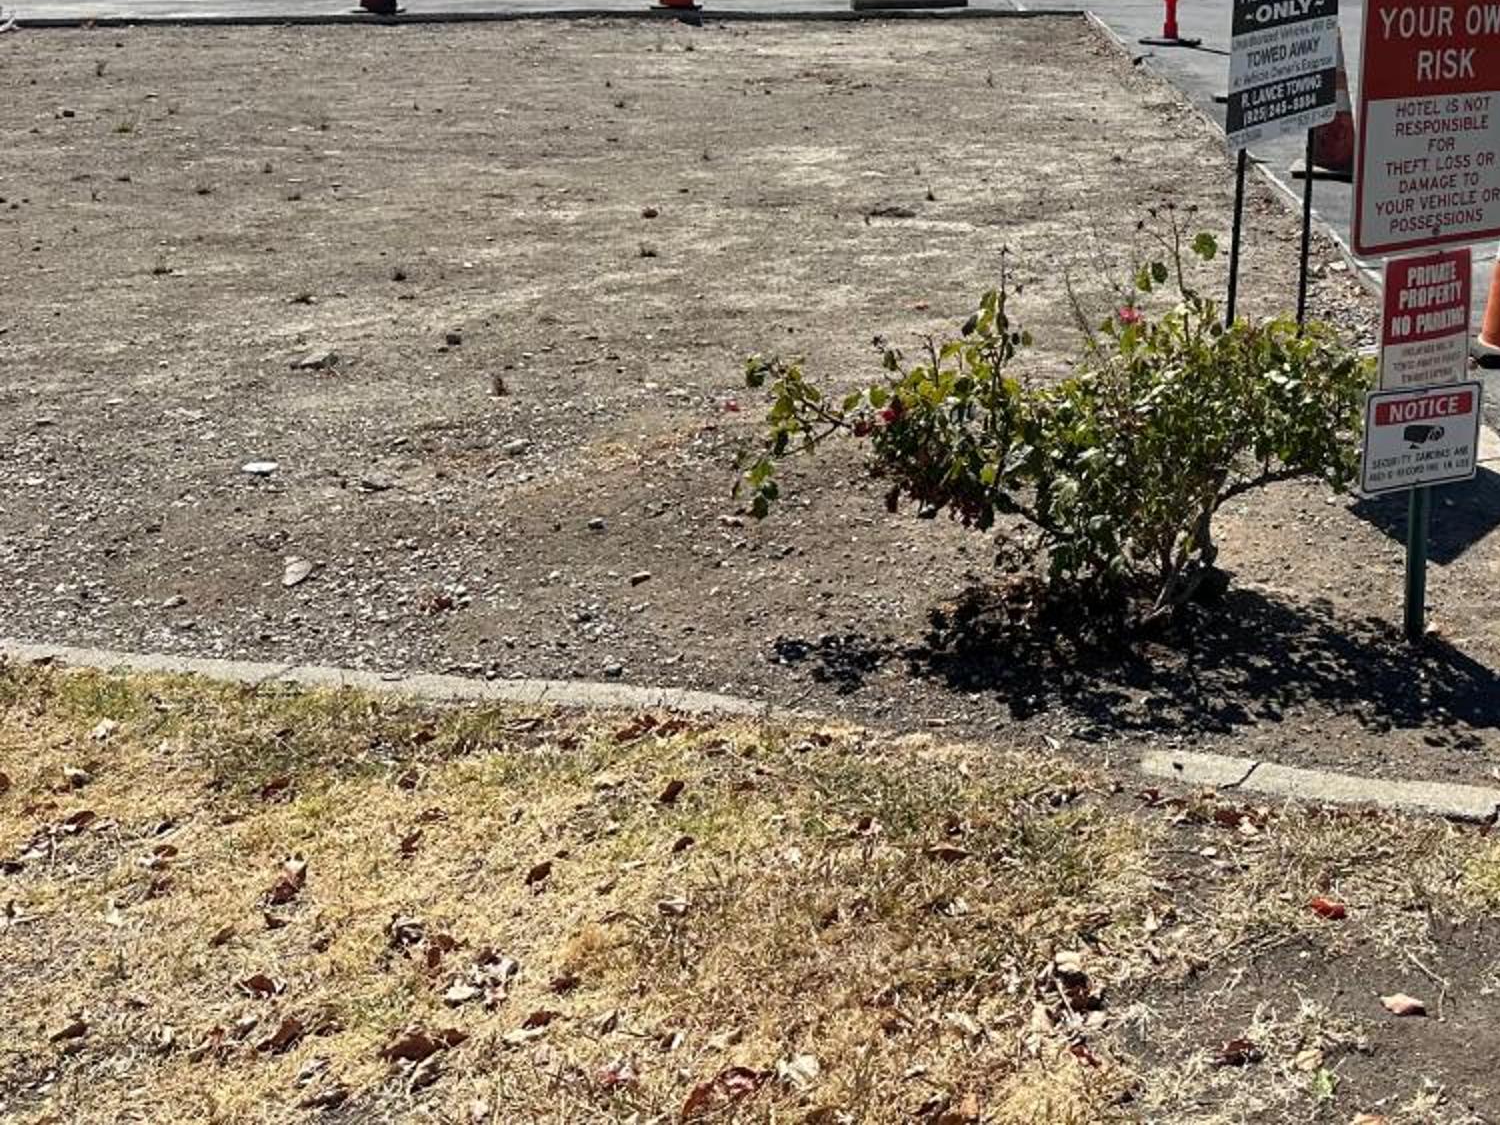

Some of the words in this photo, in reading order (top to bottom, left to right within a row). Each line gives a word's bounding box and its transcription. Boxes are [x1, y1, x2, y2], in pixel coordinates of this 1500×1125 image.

[1379, 6, 1453, 40] YOUR
[1247, 44, 1287, 69] TOWED
[1289, 35, 1320, 59] AWAY
[1416, 47, 1476, 81] RISK
[1396, 100, 1441, 118] HOTEL
[1446, 98, 1459, 113] IS
[1464, 96, 1492, 112] NOT
[1395, 114, 1489, 137] RESPONSIBLE
[1427, 137, 1456, 152] FOR
[1436, 154, 1471, 171] LOSS
[1477, 151, 1495, 167] OR
[1398, 174, 1457, 194] DAMAGE
[1463, 171, 1480, 186] TO
[1375, 194, 1415, 216] YOUR
[1420, 190, 1476, 210] VEHICLE
[1389, 207, 1484, 234] POSSESSIONS
[1407, 259, 1457, 288] PRIVATE
[1399, 280, 1462, 310] PROPERTY
[1391, 313, 1411, 337] NO
[1416, 307, 1466, 335] PARKING
[1389, 395, 1459, 423] NOTICE
